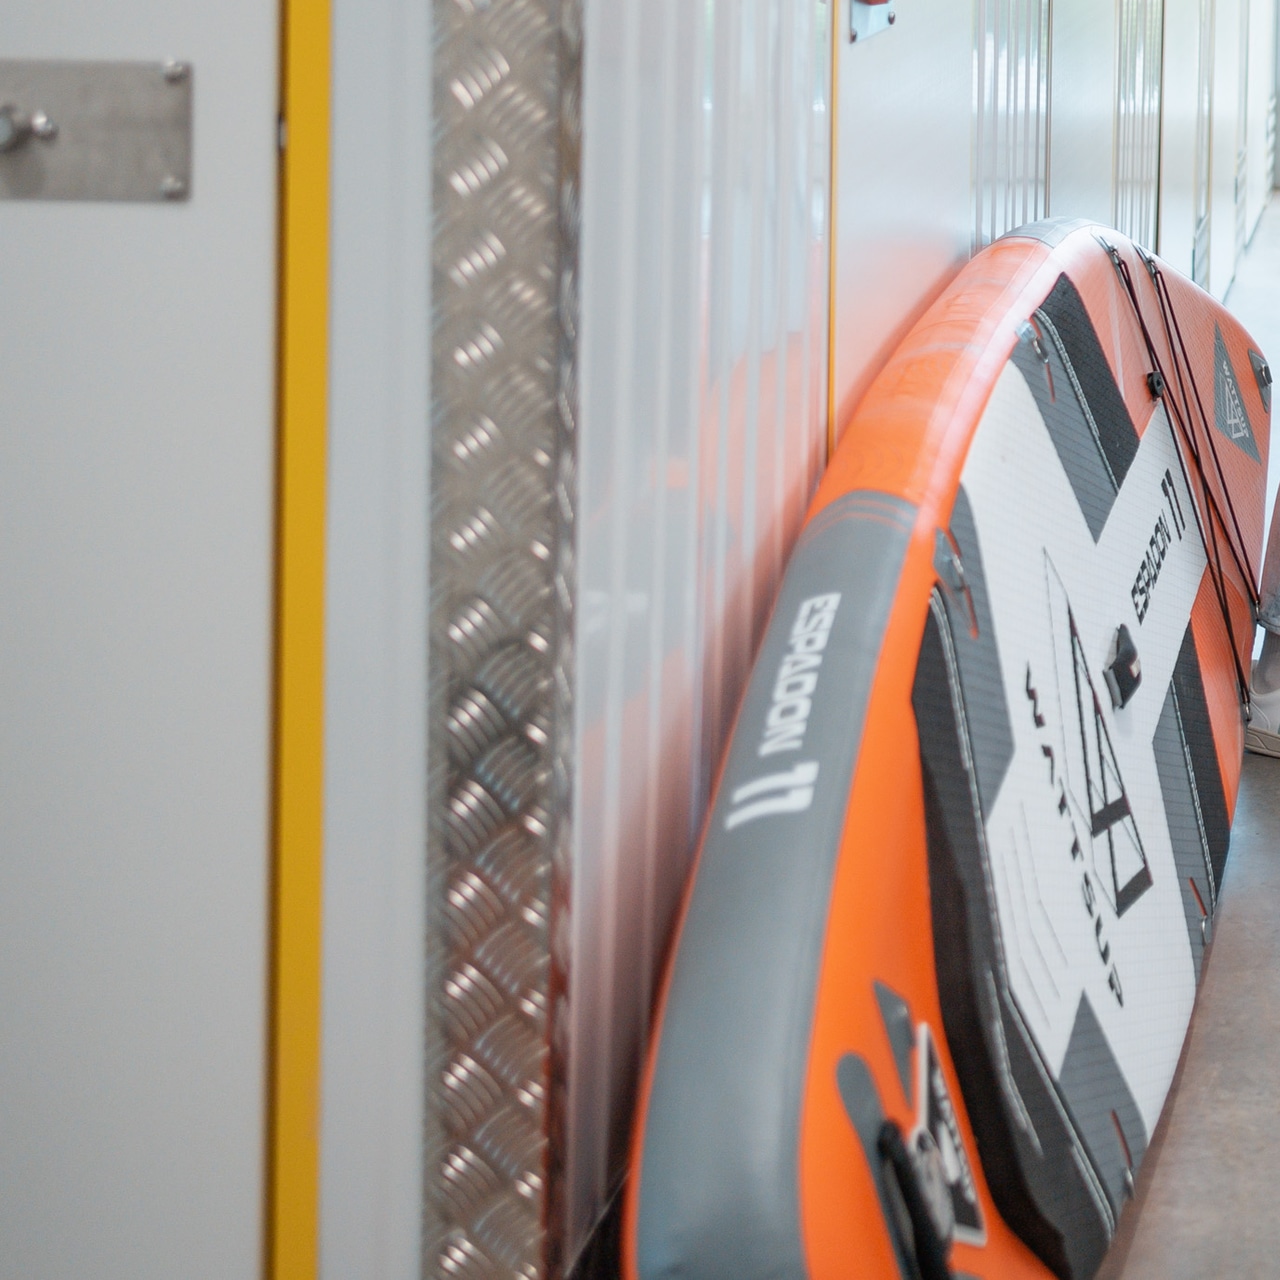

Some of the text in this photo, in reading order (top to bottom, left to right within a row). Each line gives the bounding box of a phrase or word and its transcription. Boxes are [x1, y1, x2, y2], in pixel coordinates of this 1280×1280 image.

[1223, 360, 1249, 439] WATTSUP
[1131, 468, 1186, 626] ESPADON 11
[725, 591, 842, 831] ESPADON 11
[1026, 660, 1124, 1009] WATTSUP
